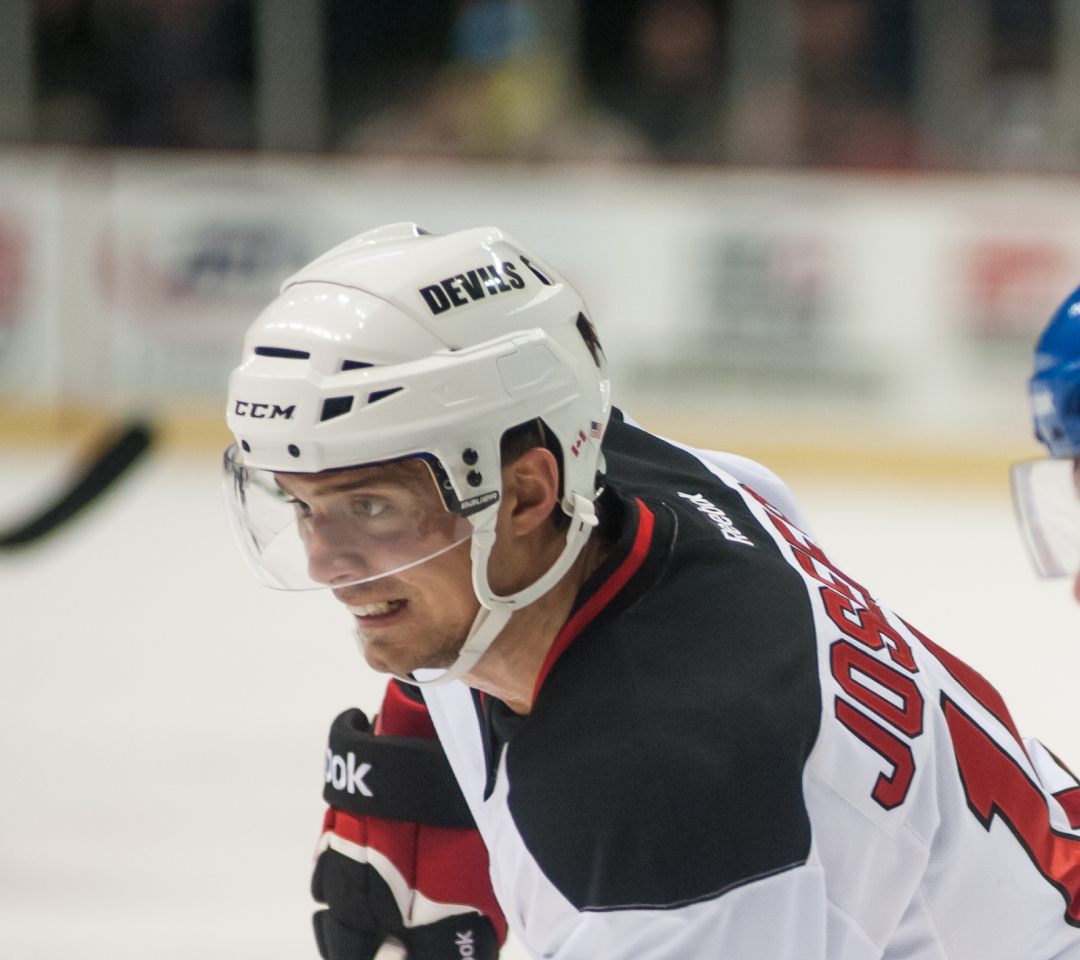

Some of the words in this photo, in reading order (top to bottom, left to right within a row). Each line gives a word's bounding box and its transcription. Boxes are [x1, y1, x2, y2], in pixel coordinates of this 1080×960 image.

[418, 261, 526, 316] DEVILS
[235, 400, 296, 420] CCM
[677, 491, 755, 547] Reebok
